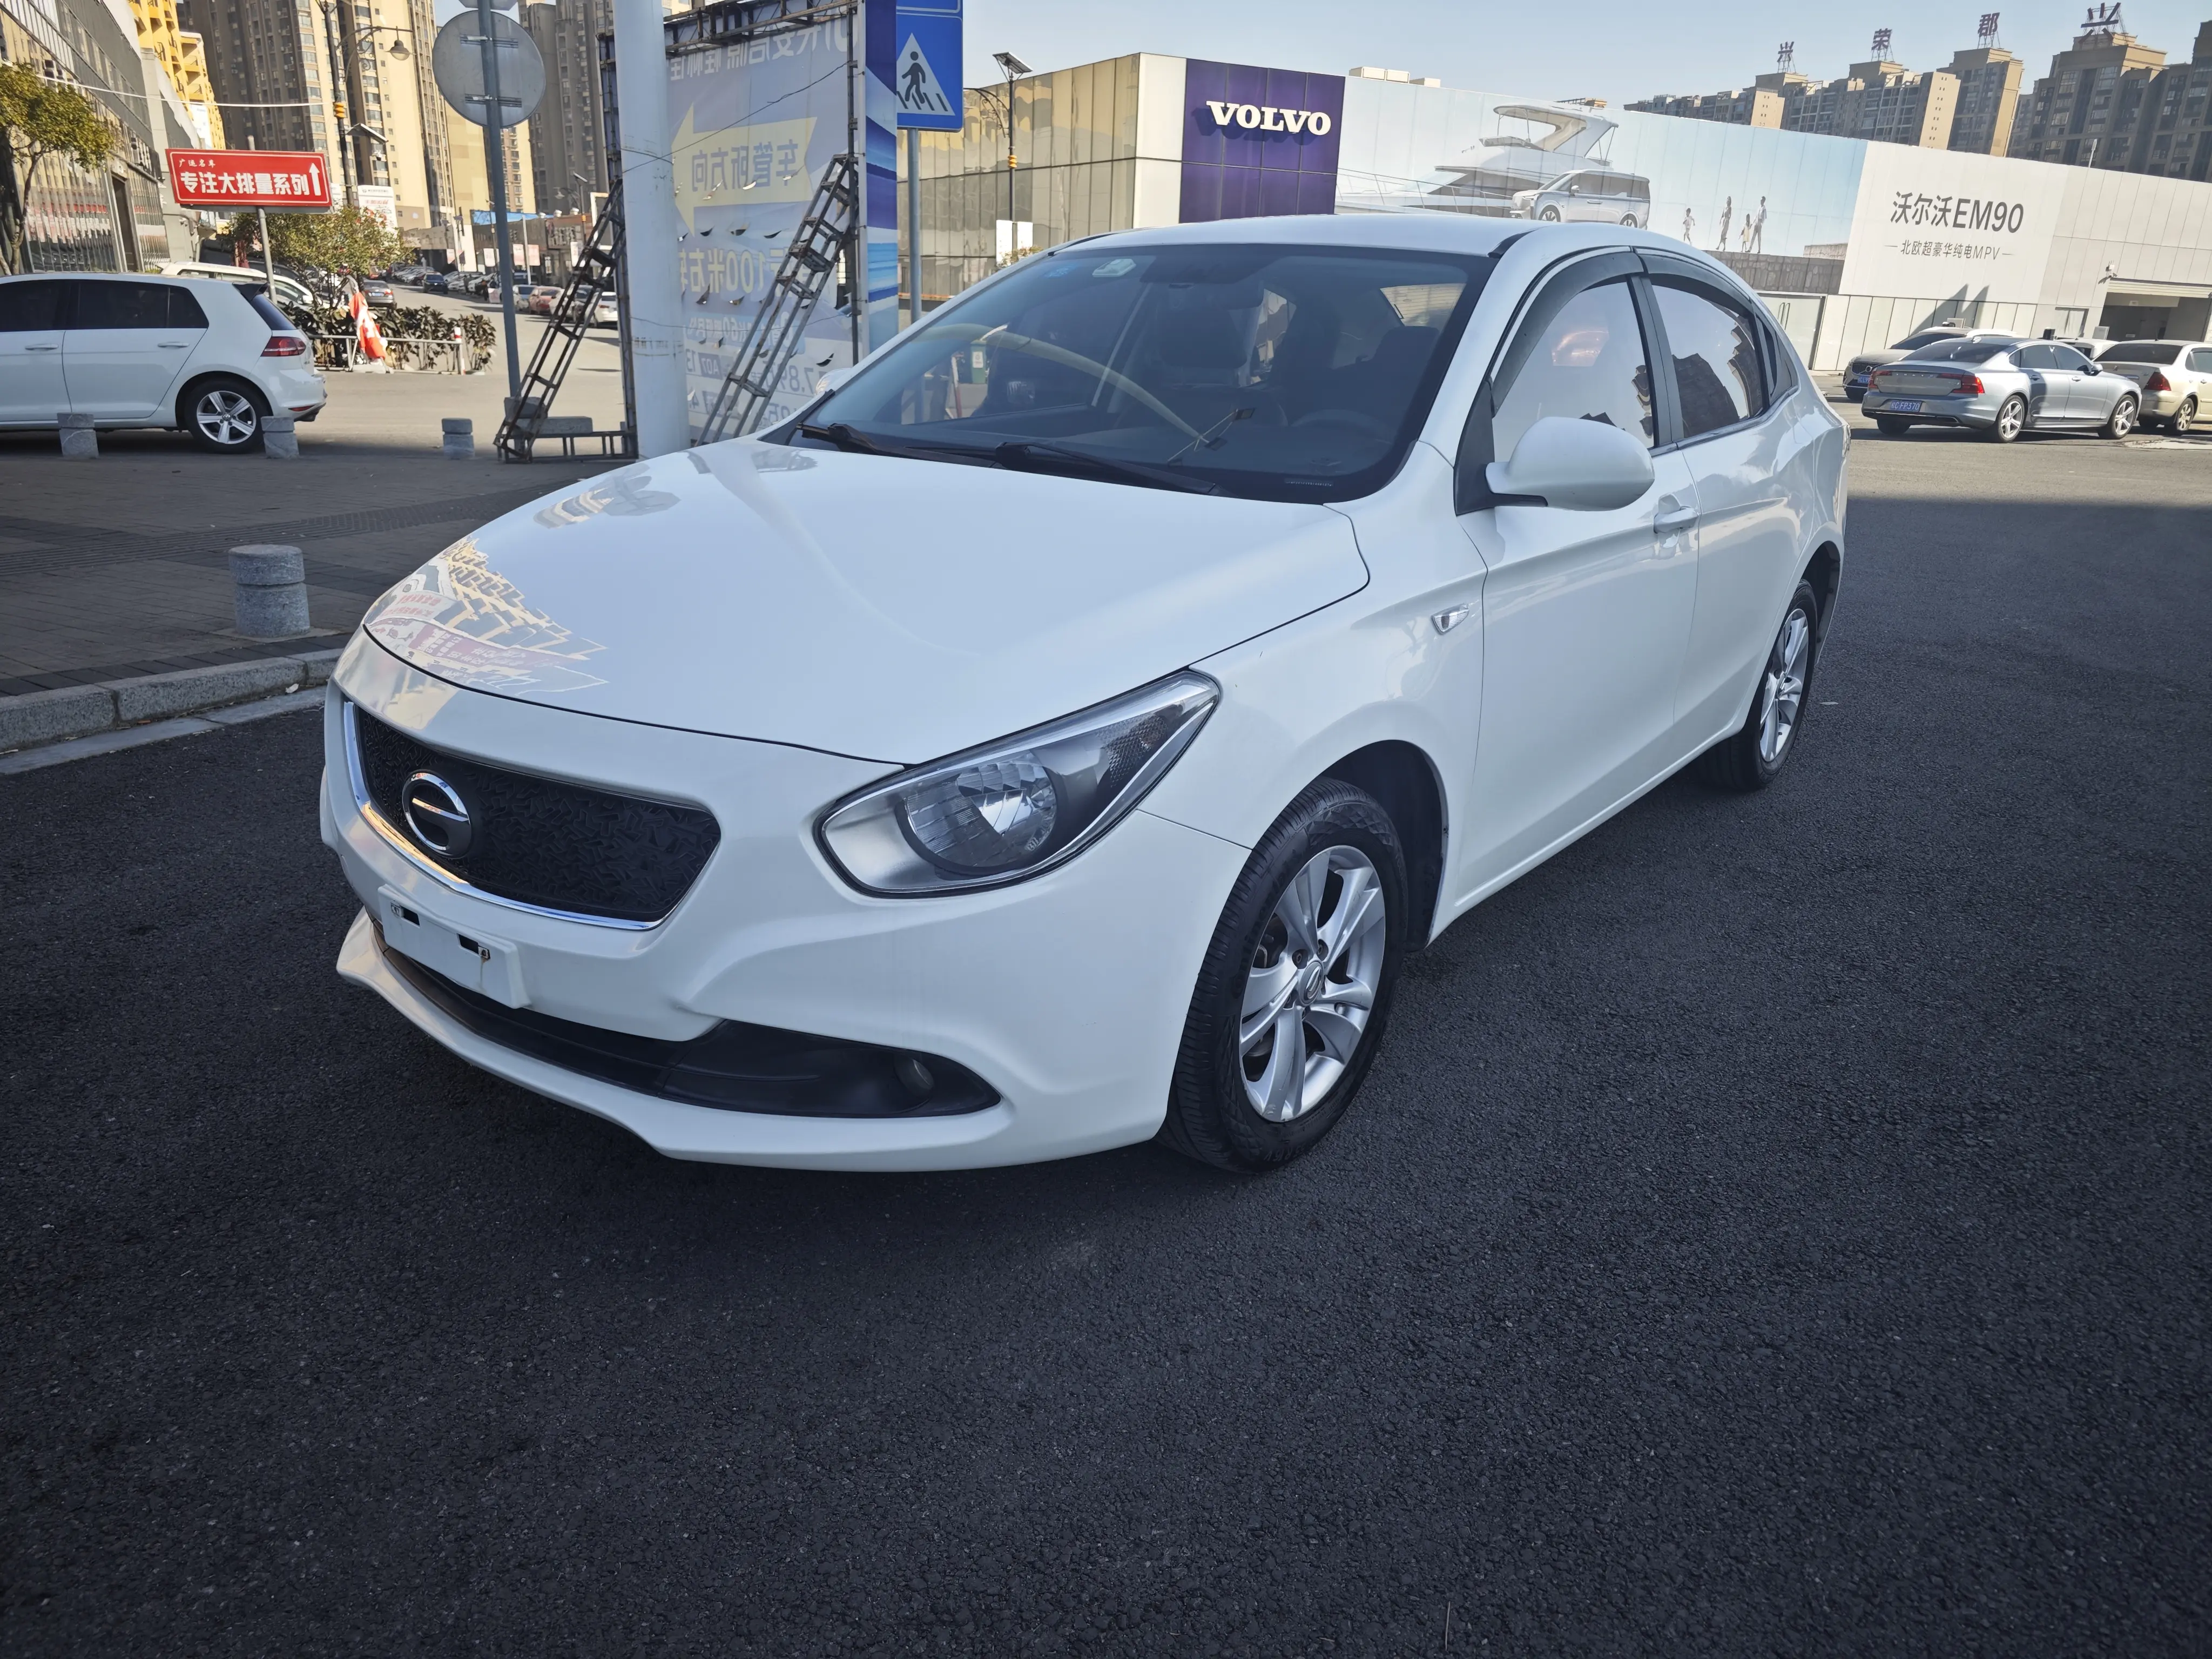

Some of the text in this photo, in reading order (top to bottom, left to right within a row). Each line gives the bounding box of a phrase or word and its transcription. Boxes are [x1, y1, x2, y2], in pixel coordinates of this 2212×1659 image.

[1777, 41, 1795, 63] 兴
[1871, 28, 1892, 51] 荣
[1978, 12, 2000, 37] 郡
[1206, 100, 1331, 135] VOLVO
[180, 171, 310, 195] 专注大排量系列
[1890, 191, 2024, 233] 沃尔沃EM90
[1900, 239, 2000, 260] 北欧超豪华纯电MPV
